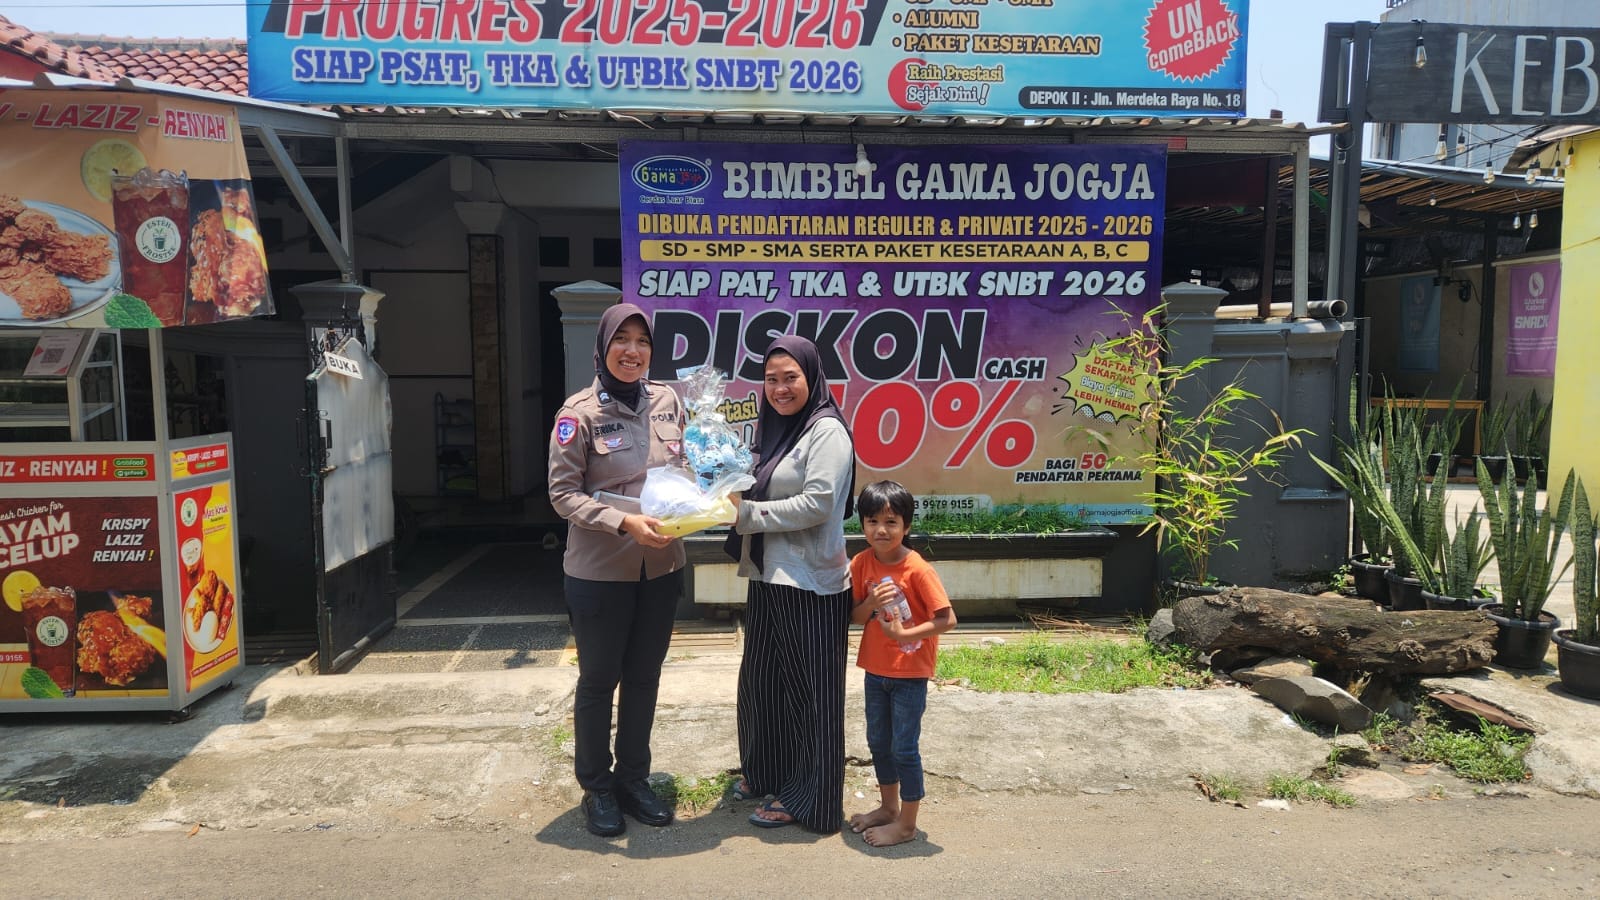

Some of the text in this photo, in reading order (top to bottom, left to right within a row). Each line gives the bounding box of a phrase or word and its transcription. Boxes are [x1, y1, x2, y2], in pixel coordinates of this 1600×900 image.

[285, 0, 864, 49] PROGRES 2025-2026
[904, 10, 979, 28] ALUMNI
[1167, 0, 1204, 40] UN
[904, 33, 1101, 54] PAKET KESETARAAN
[293, 48, 861, 92] SIAP PSAT, TKA & UTBK SNBT 2026
[908, 65, 1003, 82] Raih Prestasi
[1450, 32, 1600, 116] KEB
[907, 87, 948, 104] Sejak
[1030, 91, 1068, 105] DEPOK
[1072, 92, 1080, 105] II
[1091, 92, 1113, 106] Jln.
[1116, 93, 1167, 106] Merdeka
[1171, 93, 1199, 109] Raya
[1203, 94, 1222, 107] No.
[1226, 95, 1241, 107] 18
[33, 103, 142, 133] LAZIZ
[163, 108, 228, 141] RENYAH
[723, 161, 1155, 200] BIMBEL GAMA JOGJA
[638, 213, 713, 235] DIBUKA
[718, 215, 849, 235] PENDAFTARAN
[854, 215, 935, 235] REGULER
[939, 218, 954, 235] &
[958, 215, 1033, 235] PRIVATE
[1038, 215, 1087, 236] 2025
[1103, 215, 1152, 236] 2026
[662, 242, 688, 257] SD
[706, 243, 746, 257] SMP
[763, 243, 804, 257] SMA
[809, 244, 869, 258] SERTA
[875, 244, 934, 258] PAKET
[940, 244, 1064, 258] KESETARAAN
[1070, 244, 1088, 260] A,
[1094, 244, 1110, 259] B,
[1116, 243, 1128, 258] C
[639, 269, 1147, 302] SIAP PAT, TKA & UTBK SNBT 2026
[1514, 314, 1550, 329] SNACK
[647, 308, 1048, 382] DISKON CASH
[328, 355, 360, 374] BUKA
[1074, 389, 1137, 413] LEBIH HEMAT
[594, 422, 625, 437] ERIKA
[829, 381, 1037, 470] 0%
[29, 460, 97, 477] RENYAH
[102, 459, 107, 476] !
[1046, 453, 1108, 470] BAGI 50
[1016, 470, 1143, 482] PENDAFTAR PERTAMA
[17, 504, 49, 518] Chicken
[49, 501, 64, 515] for
[950, 499, 974, 509] 9155
[101, 518, 151, 531] KRISPY
[105, 533, 144, 546] LAZIZ
[92, 549, 154, 562] RENYAH !
